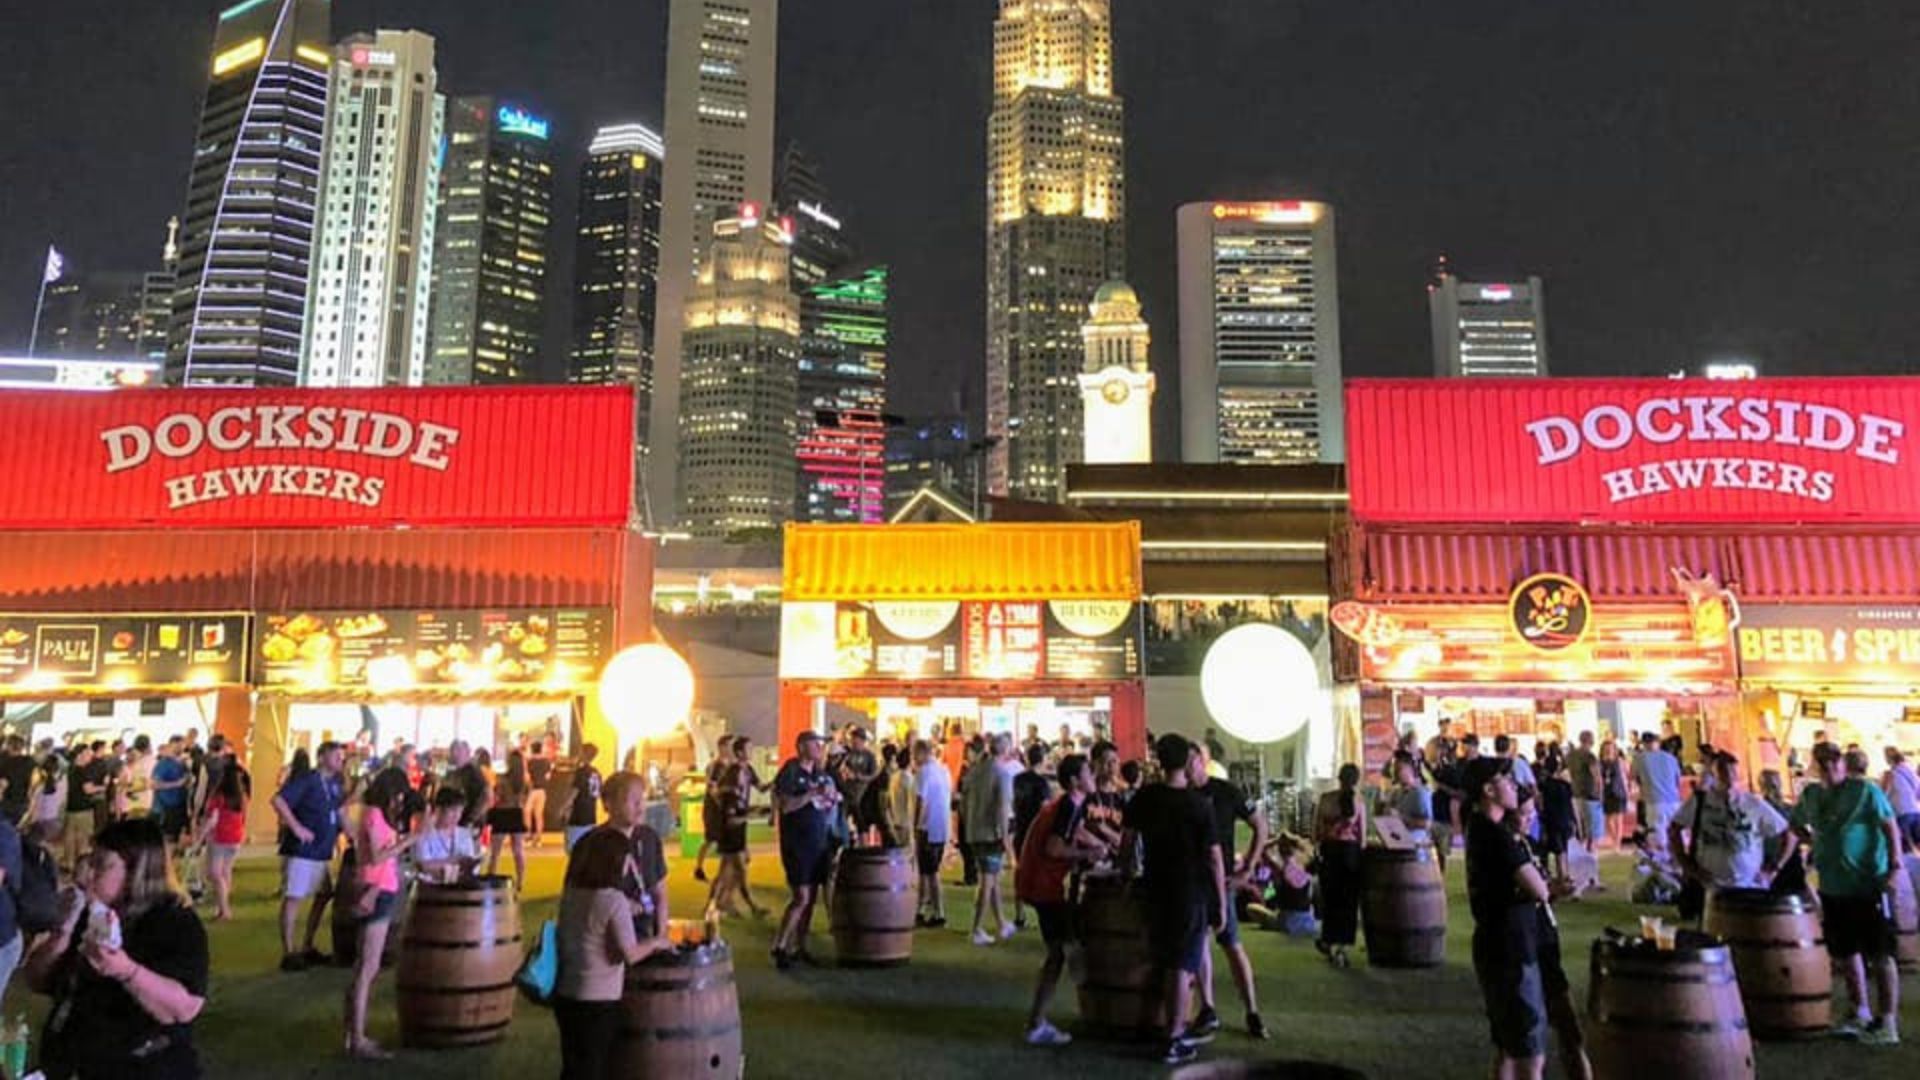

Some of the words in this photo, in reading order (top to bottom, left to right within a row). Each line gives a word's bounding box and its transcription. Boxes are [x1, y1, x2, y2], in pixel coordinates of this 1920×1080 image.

[100, 405, 459, 473] DOCKSIDE
[1524, 396, 1904, 466] DOCKSIDE
[164, 464, 385, 509] HAWKERS
[1602, 457, 1835, 503] HAWKERS
[42, 639, 91, 660] PAUL
[1739, 628, 1827, 662] BEER
